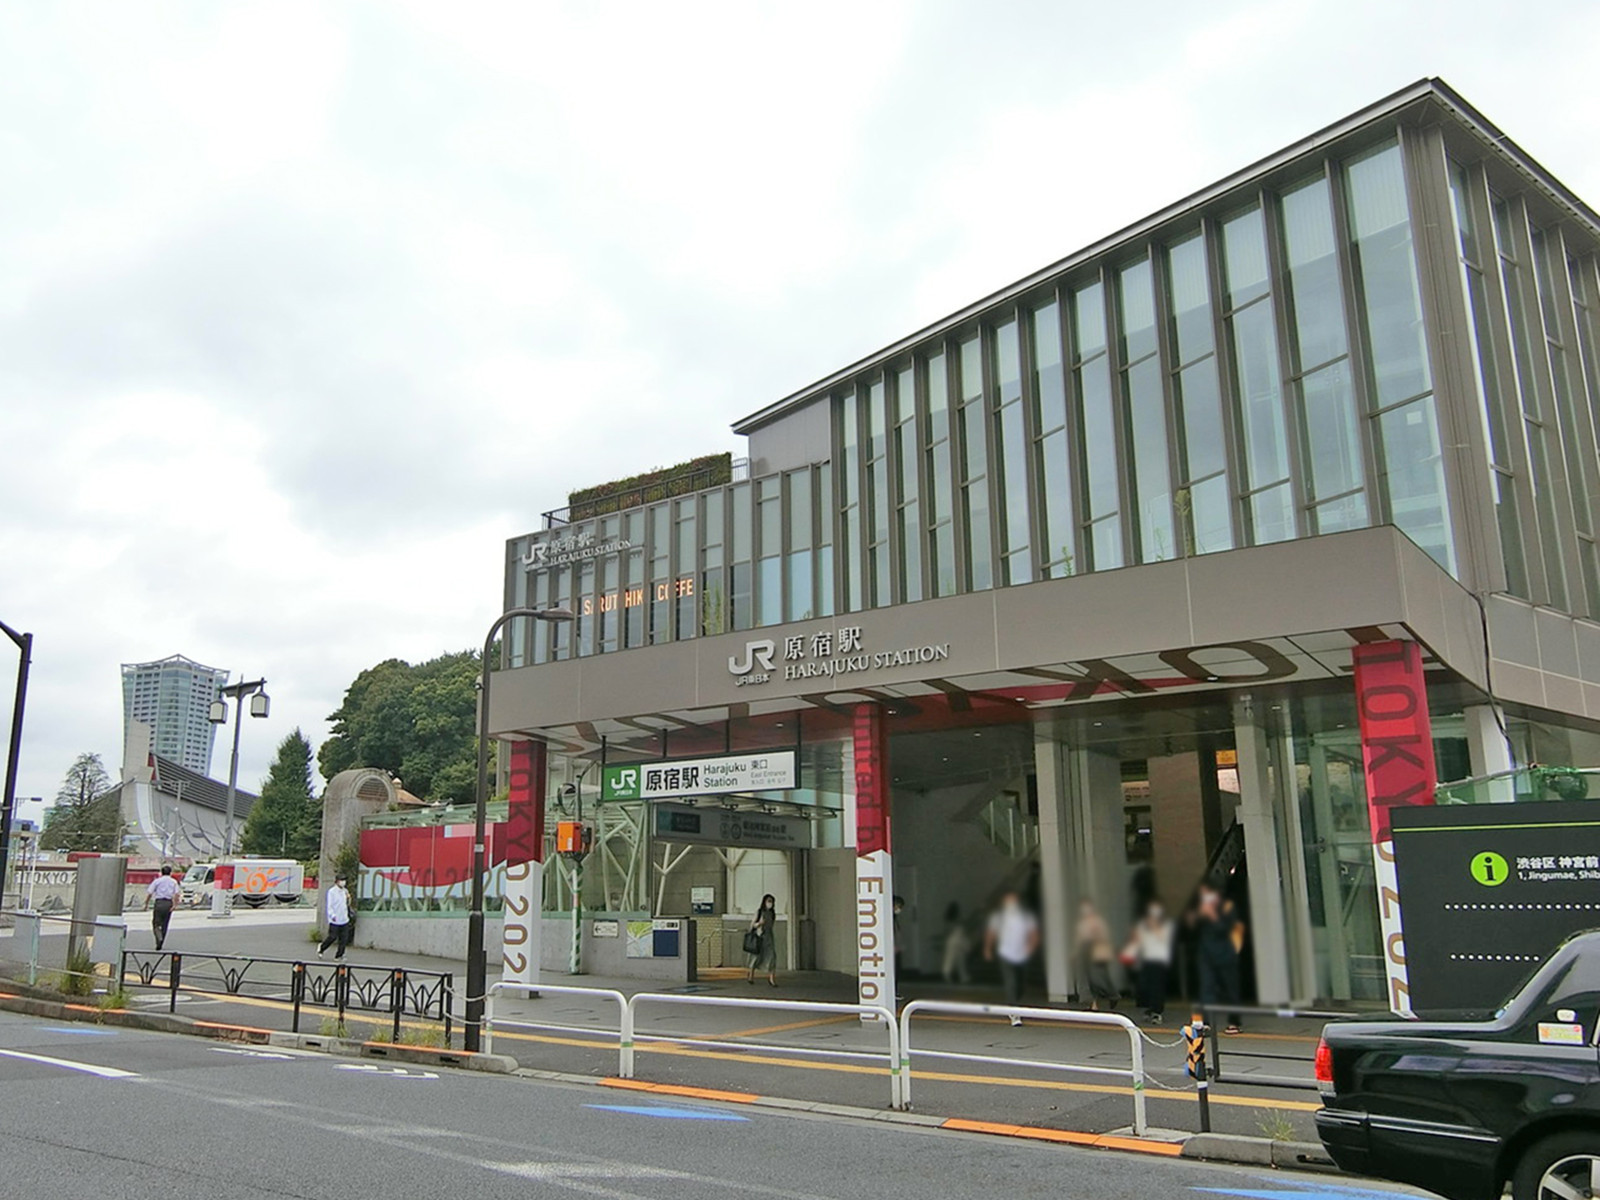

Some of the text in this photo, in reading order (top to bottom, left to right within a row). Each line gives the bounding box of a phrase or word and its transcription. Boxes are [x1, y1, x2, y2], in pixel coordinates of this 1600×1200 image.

[522, 543, 549, 564] JR
[550, 539, 632, 565] HARAJUKU STATION
[783, 627, 863, 661] 原宿駅
[728, 639, 777, 676] JR
[785, 644, 949, 679] HARAJUKU STATION
[611, 769, 637, 790] JR
[645, 767, 700, 792] 原宿駅
[704, 762, 747, 777] Harajuku
[704, 777, 738, 788] Station
[1516, 855, 1599, 869] 渋谷区 神宮前
[359, 868, 437, 901] TOKYO
[1528, 871, 1578, 882] Jingumae,
[502, 895, 530, 985] 202
